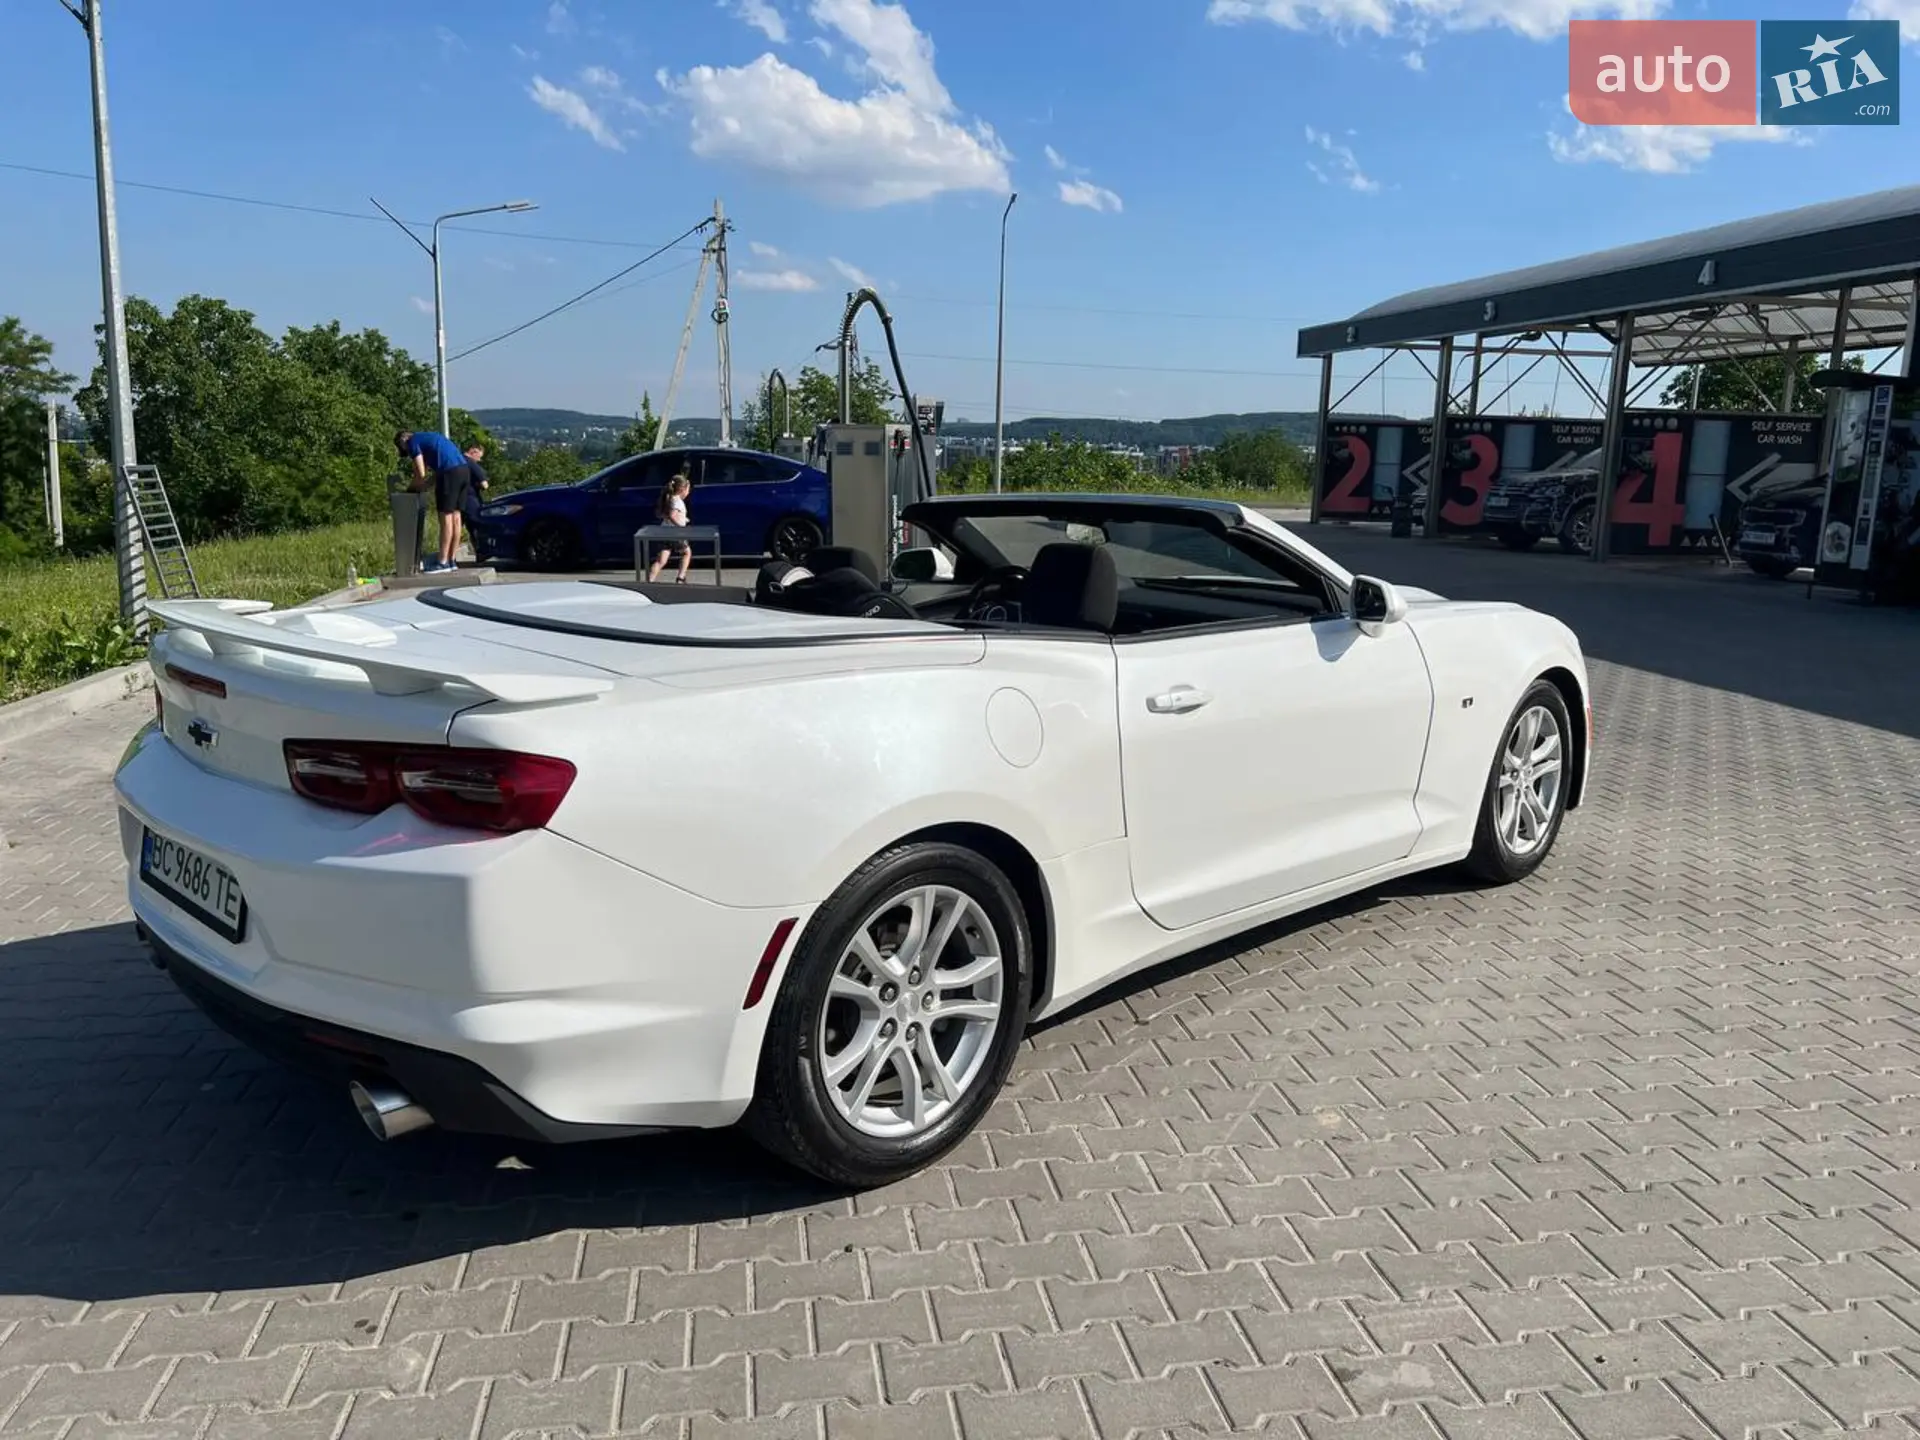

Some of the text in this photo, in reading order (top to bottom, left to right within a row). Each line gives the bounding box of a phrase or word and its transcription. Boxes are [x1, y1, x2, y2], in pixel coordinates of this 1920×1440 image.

[1697, 259, 1715, 286] 4
[1483, 301, 1496, 321] 3
[1552, 425, 1602, 435] SELF SERVICE
[1751, 421, 1812, 432] SELF SERVICE
[1557, 435, 1595, 445] CAR WASH
[1757, 434, 1803, 445] CAR WASH
[1321, 434, 1371, 513] 2
[1440, 434, 1498, 525] 3
[1611, 432, 1686, 546] 4
[152, 835, 240, 921] BC 9686 TE
